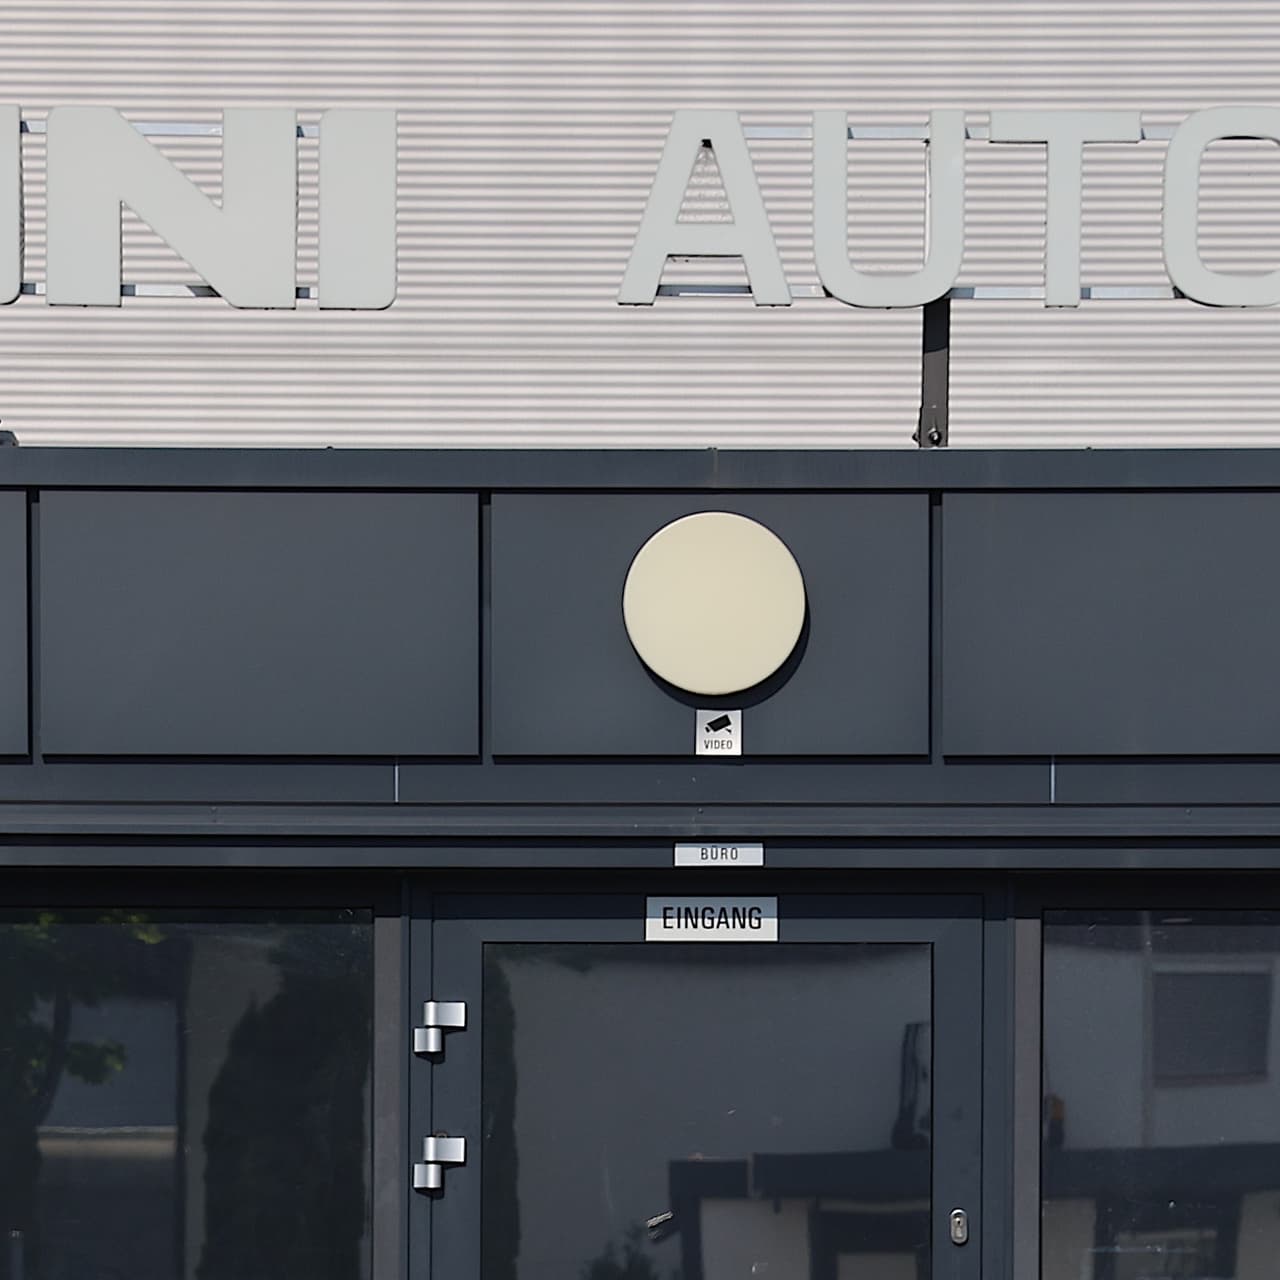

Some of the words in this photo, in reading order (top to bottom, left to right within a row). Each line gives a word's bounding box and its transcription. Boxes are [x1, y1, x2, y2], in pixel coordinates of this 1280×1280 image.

[703, 739, 733, 750] VIDEO
[700, 845, 739, 861] BÜRO
[662, 906, 763, 930] EINGANG
